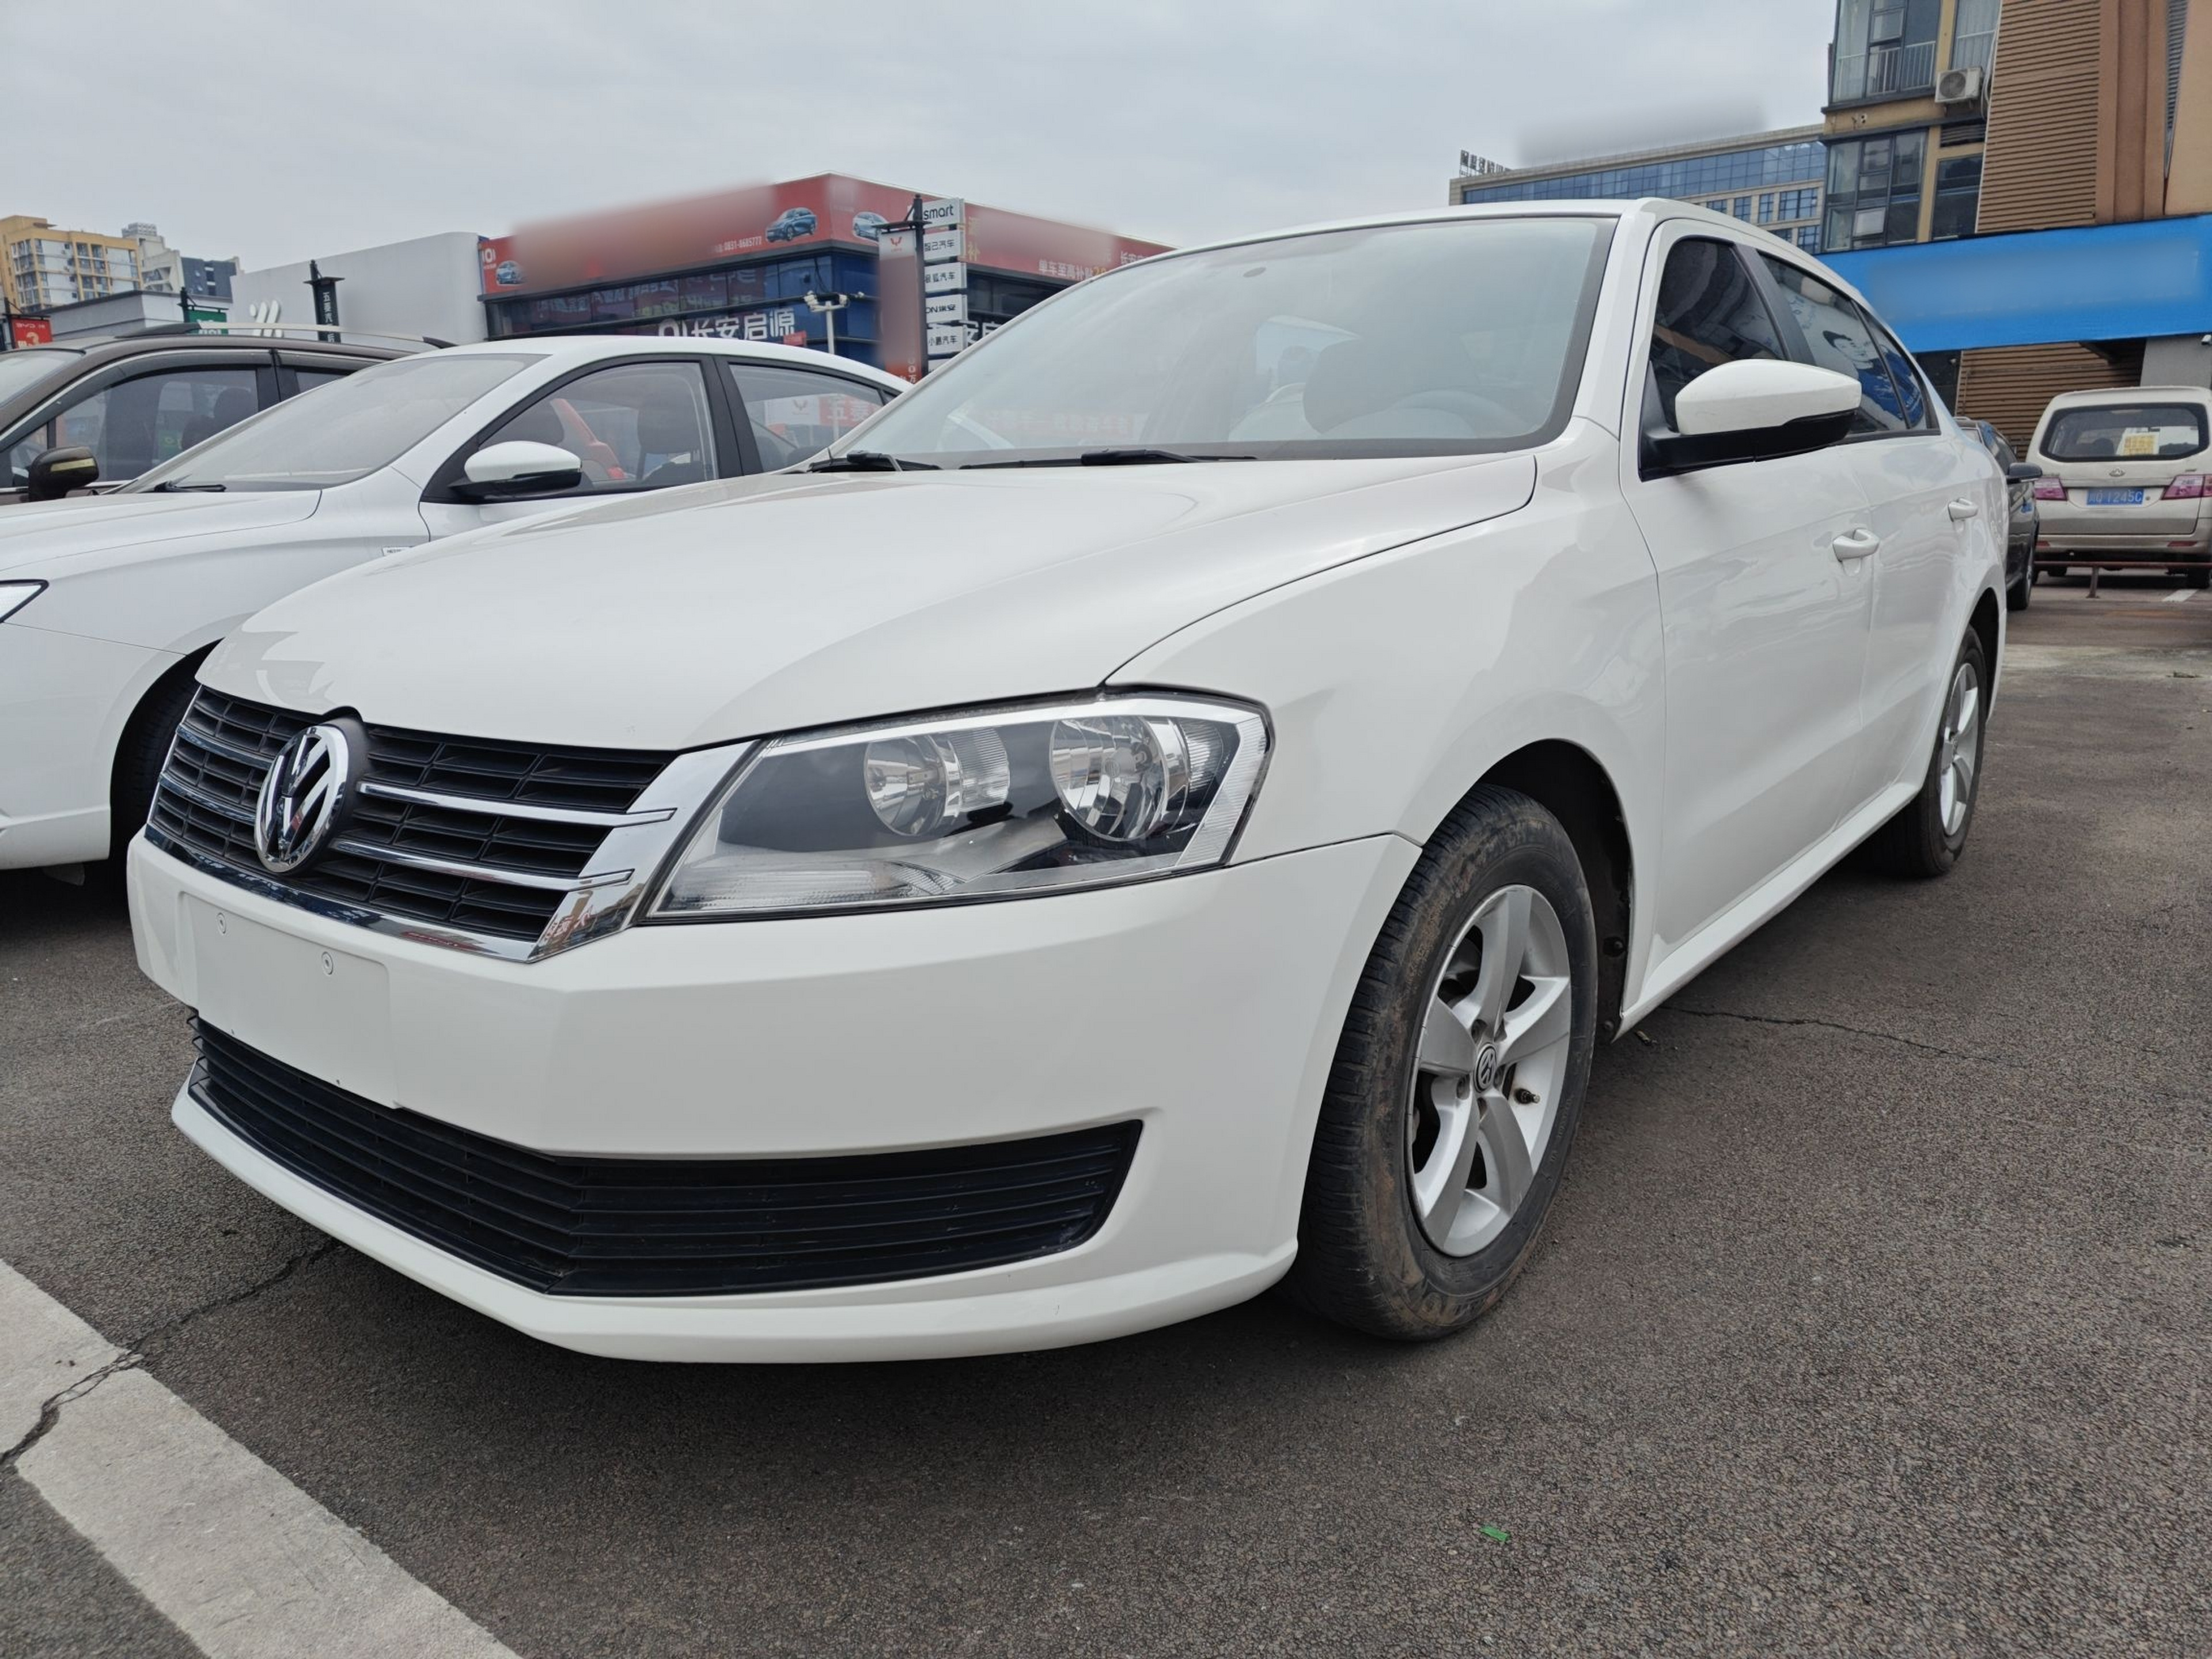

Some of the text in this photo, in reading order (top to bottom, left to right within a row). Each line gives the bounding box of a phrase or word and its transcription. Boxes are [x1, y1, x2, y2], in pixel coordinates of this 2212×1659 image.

[923, 204, 953, 220] smart
[924, 239, 955, 252] 智己汽车
[925, 304, 956, 315] ON埃安
[691, 307, 795, 340] 长安启源
